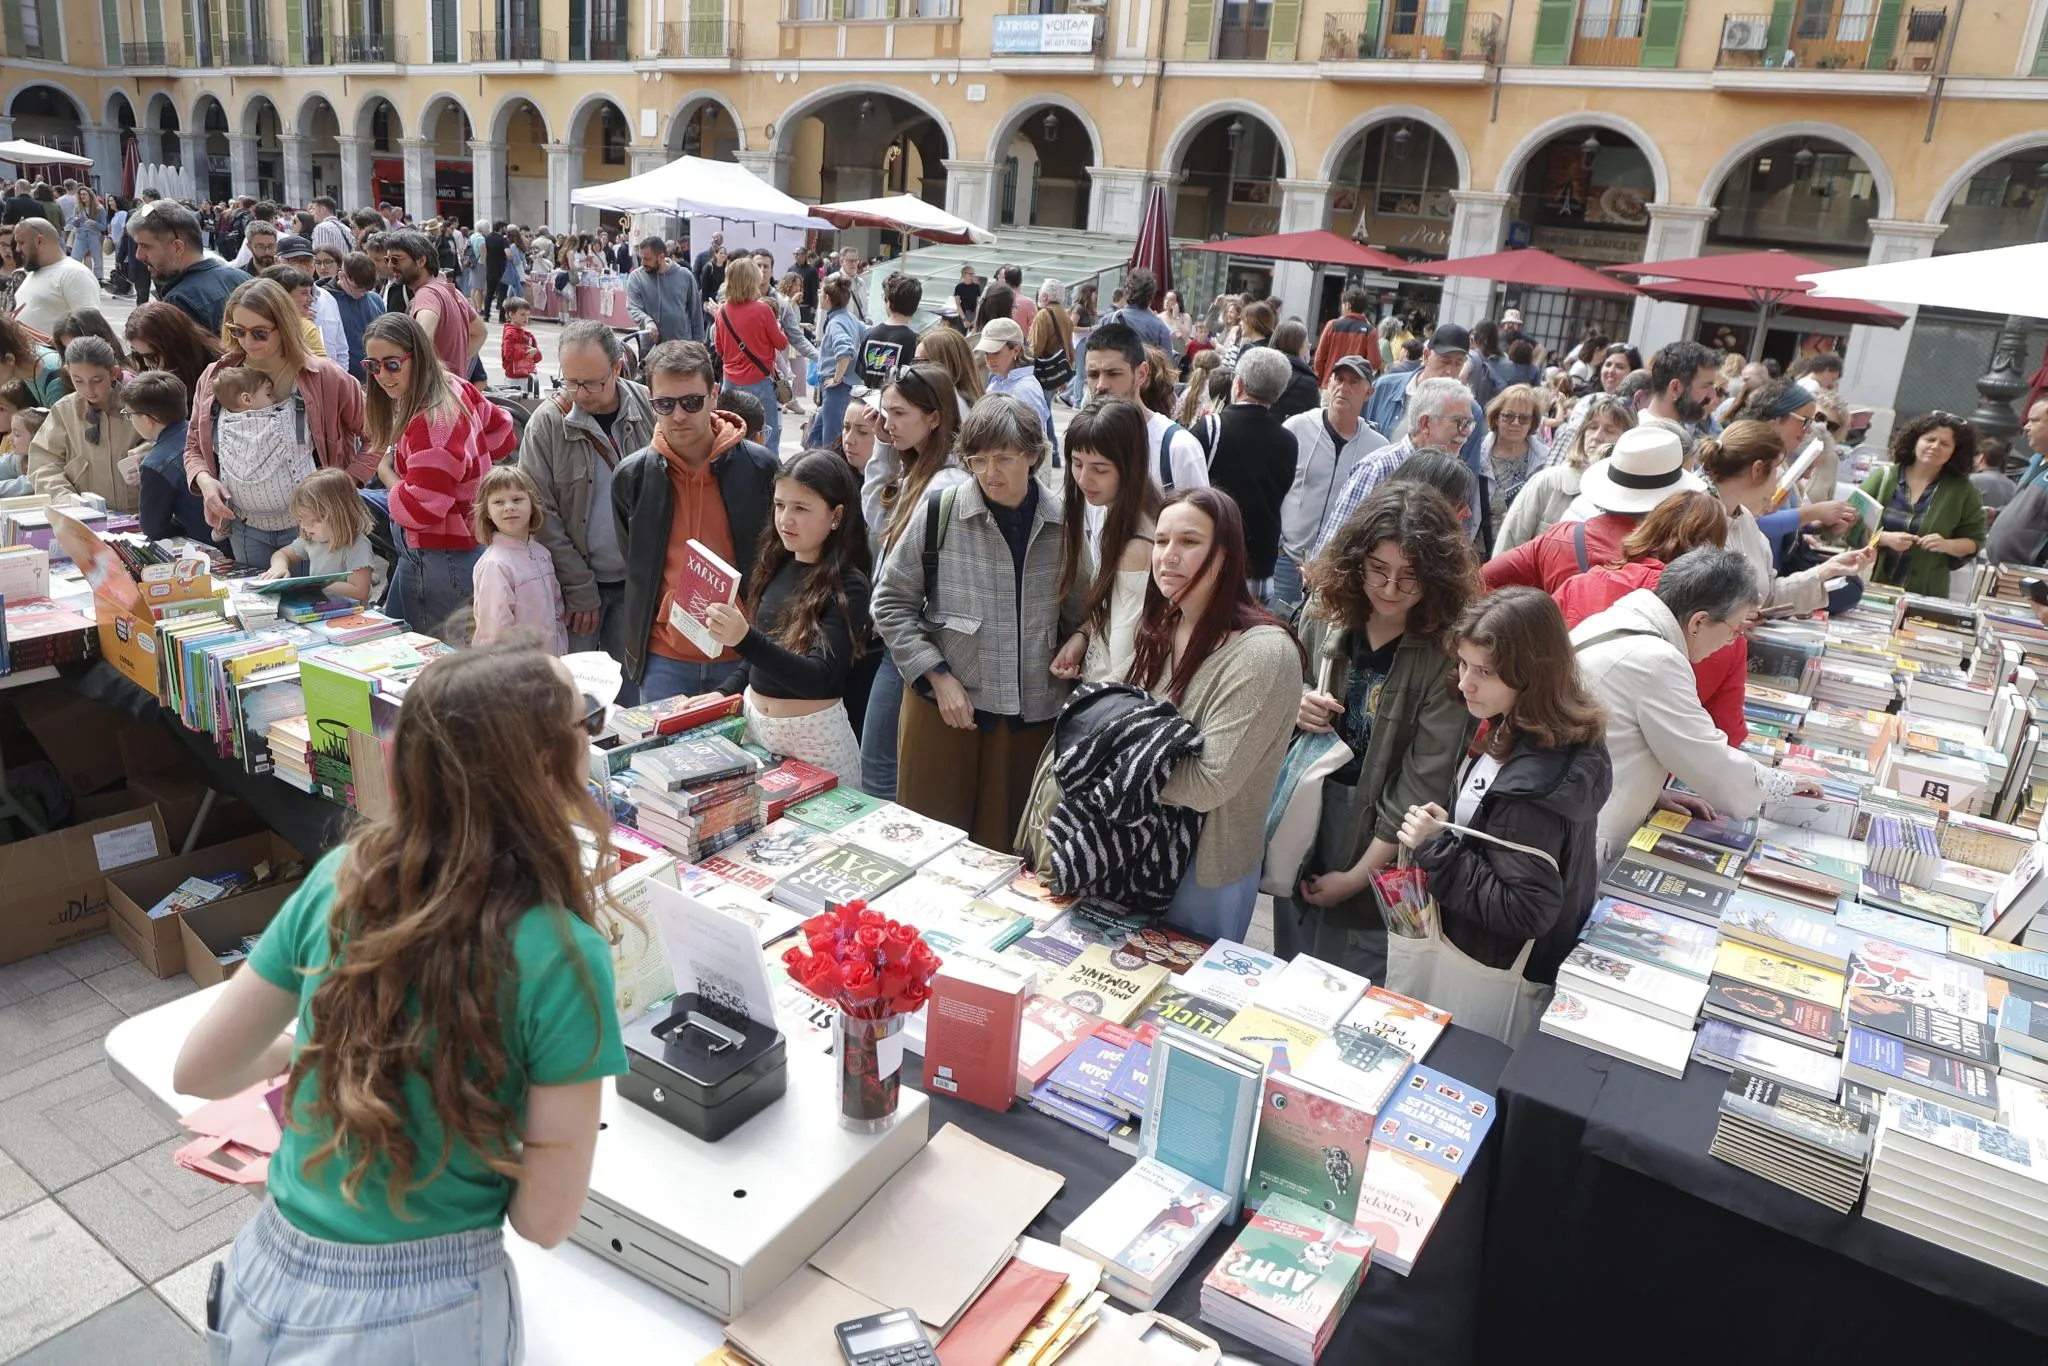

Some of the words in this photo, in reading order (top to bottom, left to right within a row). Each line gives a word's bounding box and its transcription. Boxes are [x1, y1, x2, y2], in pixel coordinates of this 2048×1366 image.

[687, 555, 727, 593] XARXES
[701, 856, 776, 890] BESTIES
[822, 850, 899, 887] PA!
[800, 867, 871, 901] PER
[1068, 974, 1081, 982] DE
[1082, 980, 1107, 992] ULLS
[1110, 988, 1132, 1000] AMB
[1353, 1022, 1389, 1040] TEVA
[1374, 1020, 1406, 1037] PELL
[1931, 1010, 1962, 1050] DAVIS
[1398, 1038, 1416, 1050] LA
[1228, 1255, 1319, 1293] APM?
[843, 1323, 863, 1332] CASIO
